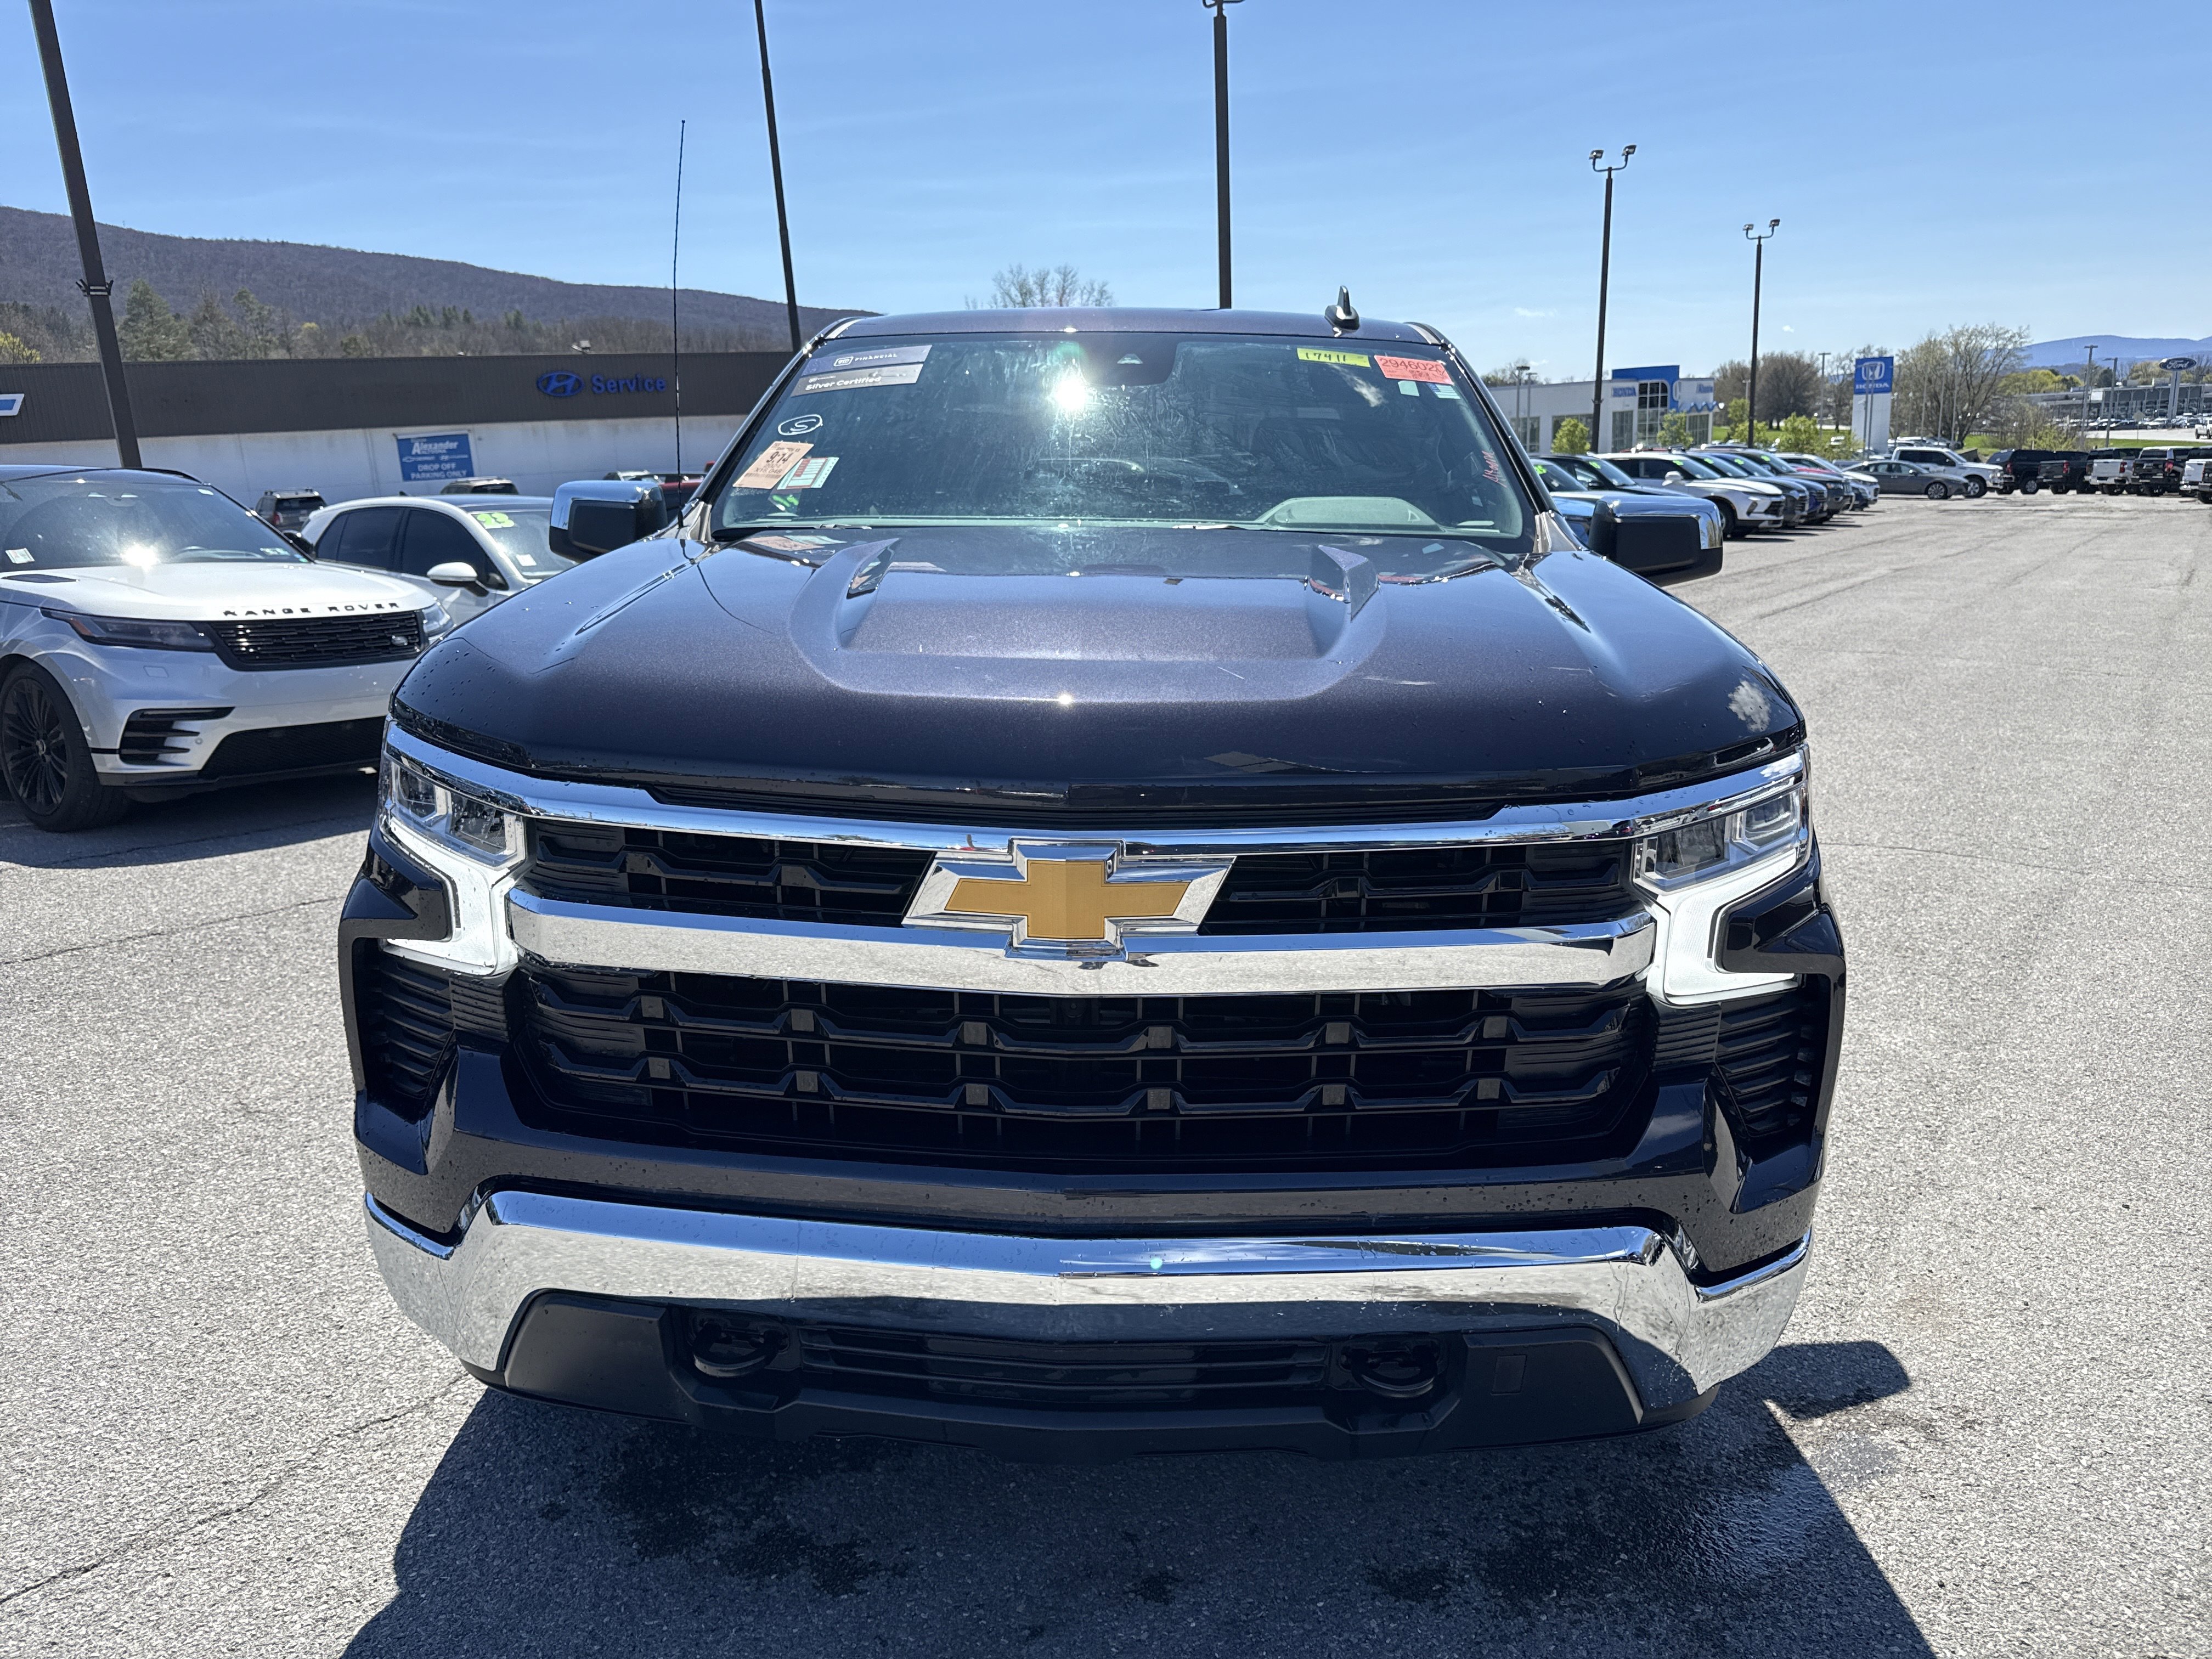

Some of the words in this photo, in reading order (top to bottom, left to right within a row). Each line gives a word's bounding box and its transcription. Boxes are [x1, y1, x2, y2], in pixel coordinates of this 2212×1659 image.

[855, 353, 898, 362] FINANCIAL
[1306, 352, 1346, 362] 17411
[1380, 358, 1445, 374] 2946020
[590, 373, 667, 394] Service
[805, 381, 836, 391] Silver
[836, 376, 882, 386] Certified
[790, 419, 816, 431] S
[412, 440, 459, 455] Alexander
[766, 451, 794, 464] 9:14
[417, 463, 439, 472] DROP
[441, 462, 456, 471] OFF
[411, 471, 445, 479] PARKING
[446, 470, 467, 478] ONLY
[476, 512, 515, 529] 23
[223, 607, 311, 616] RANGE
[328, 602, 399, 612] ROVER
